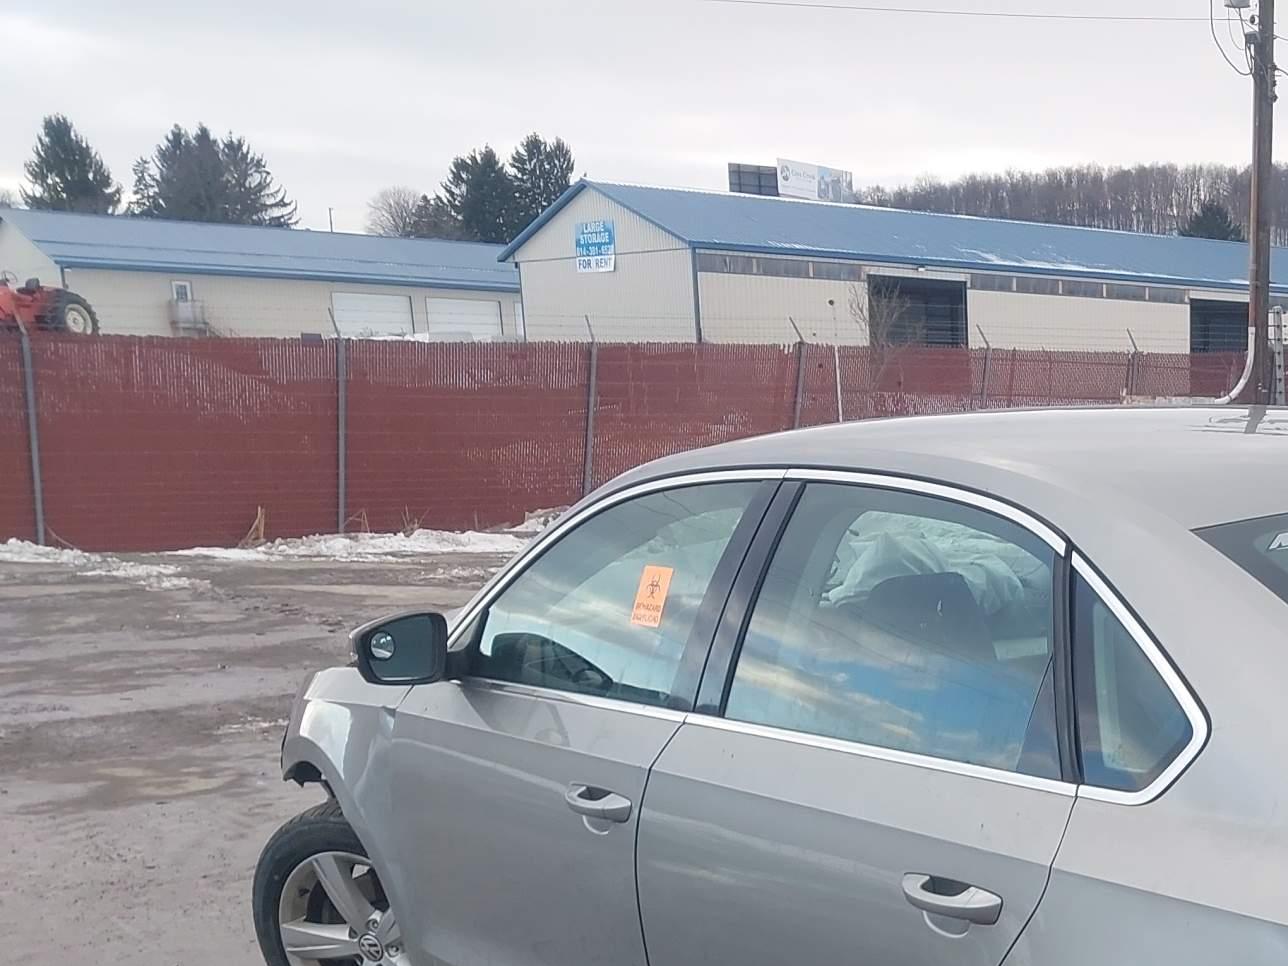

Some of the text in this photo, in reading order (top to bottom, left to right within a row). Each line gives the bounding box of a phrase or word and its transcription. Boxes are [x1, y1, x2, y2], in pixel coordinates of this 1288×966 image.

[583, 222, 605, 233] LARGE
[580, 232, 610, 245] STORAGE
[578, 257, 613, 270] FOR RENT
